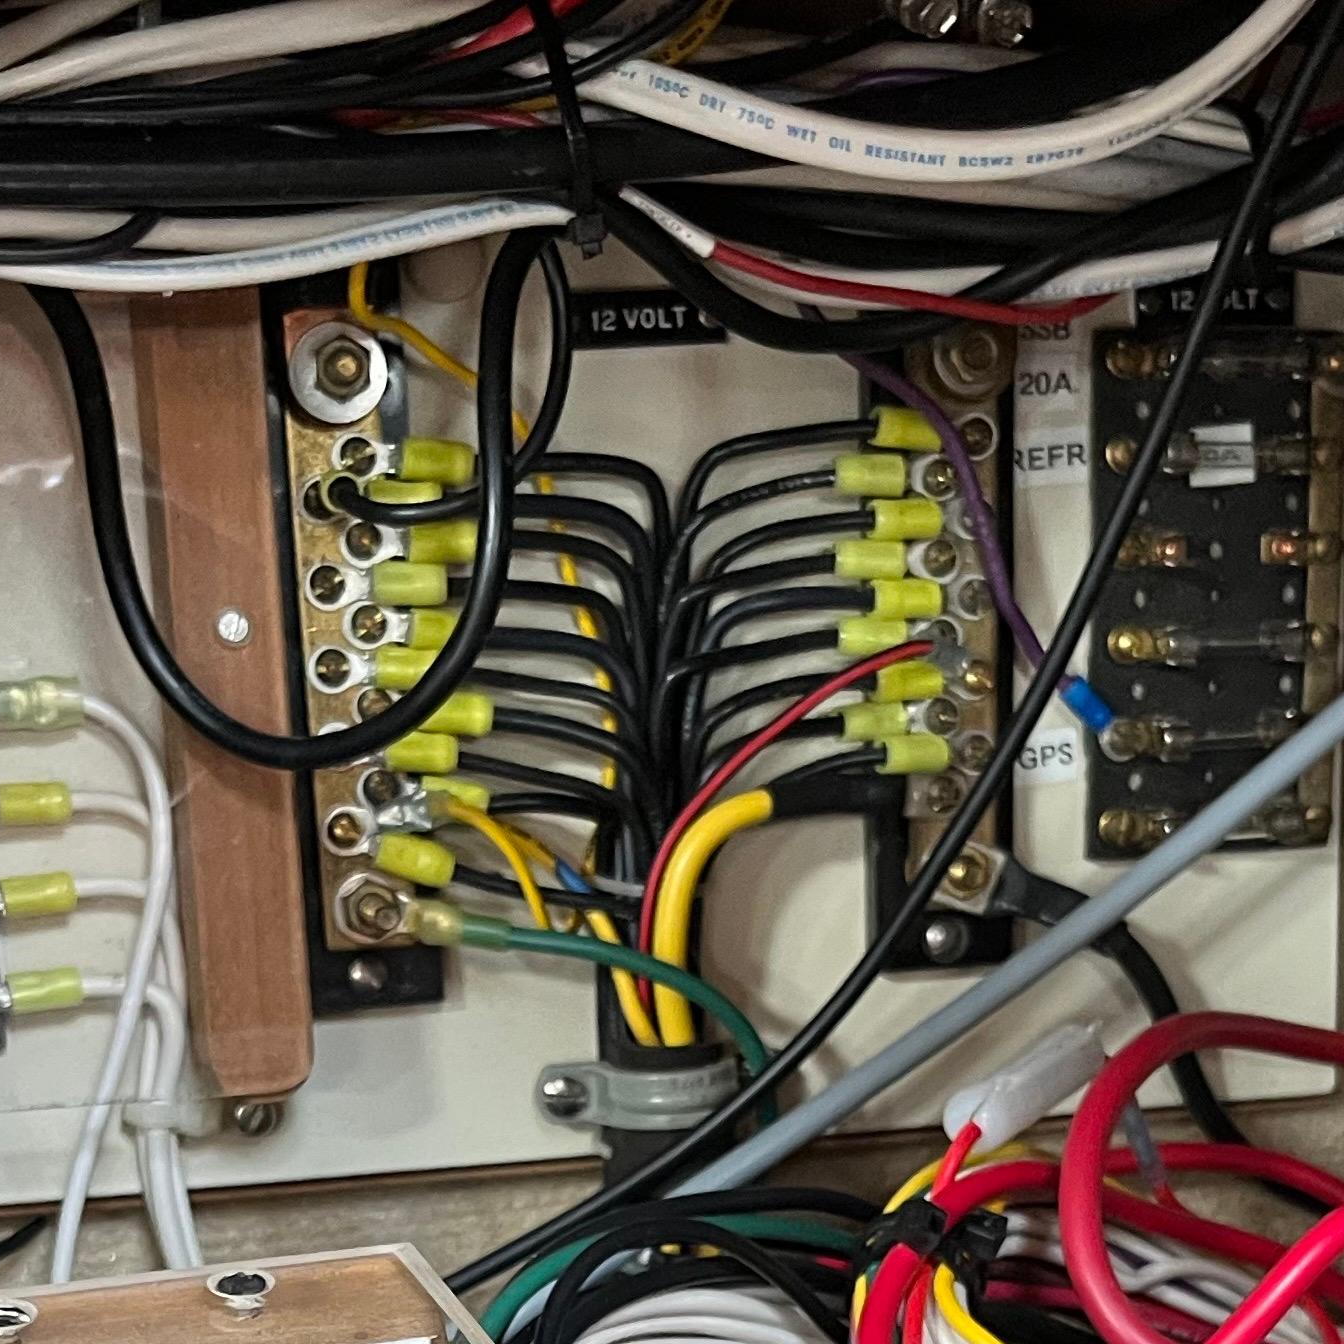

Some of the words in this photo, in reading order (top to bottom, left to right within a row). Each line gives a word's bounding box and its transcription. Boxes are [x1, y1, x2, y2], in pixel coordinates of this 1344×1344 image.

[786, 123, 817, 144] WET
[828, 135, 852, 153] OIL
[864, 142, 947, 168] RESISTANT
[1170, 287, 1196, 312] 12
[591, 309, 618, 332] 12
[622, 305, 688, 331] VOLT
[1019, 371, 1073, 397] 20A
[1017, 741, 1075, 772] GPS
